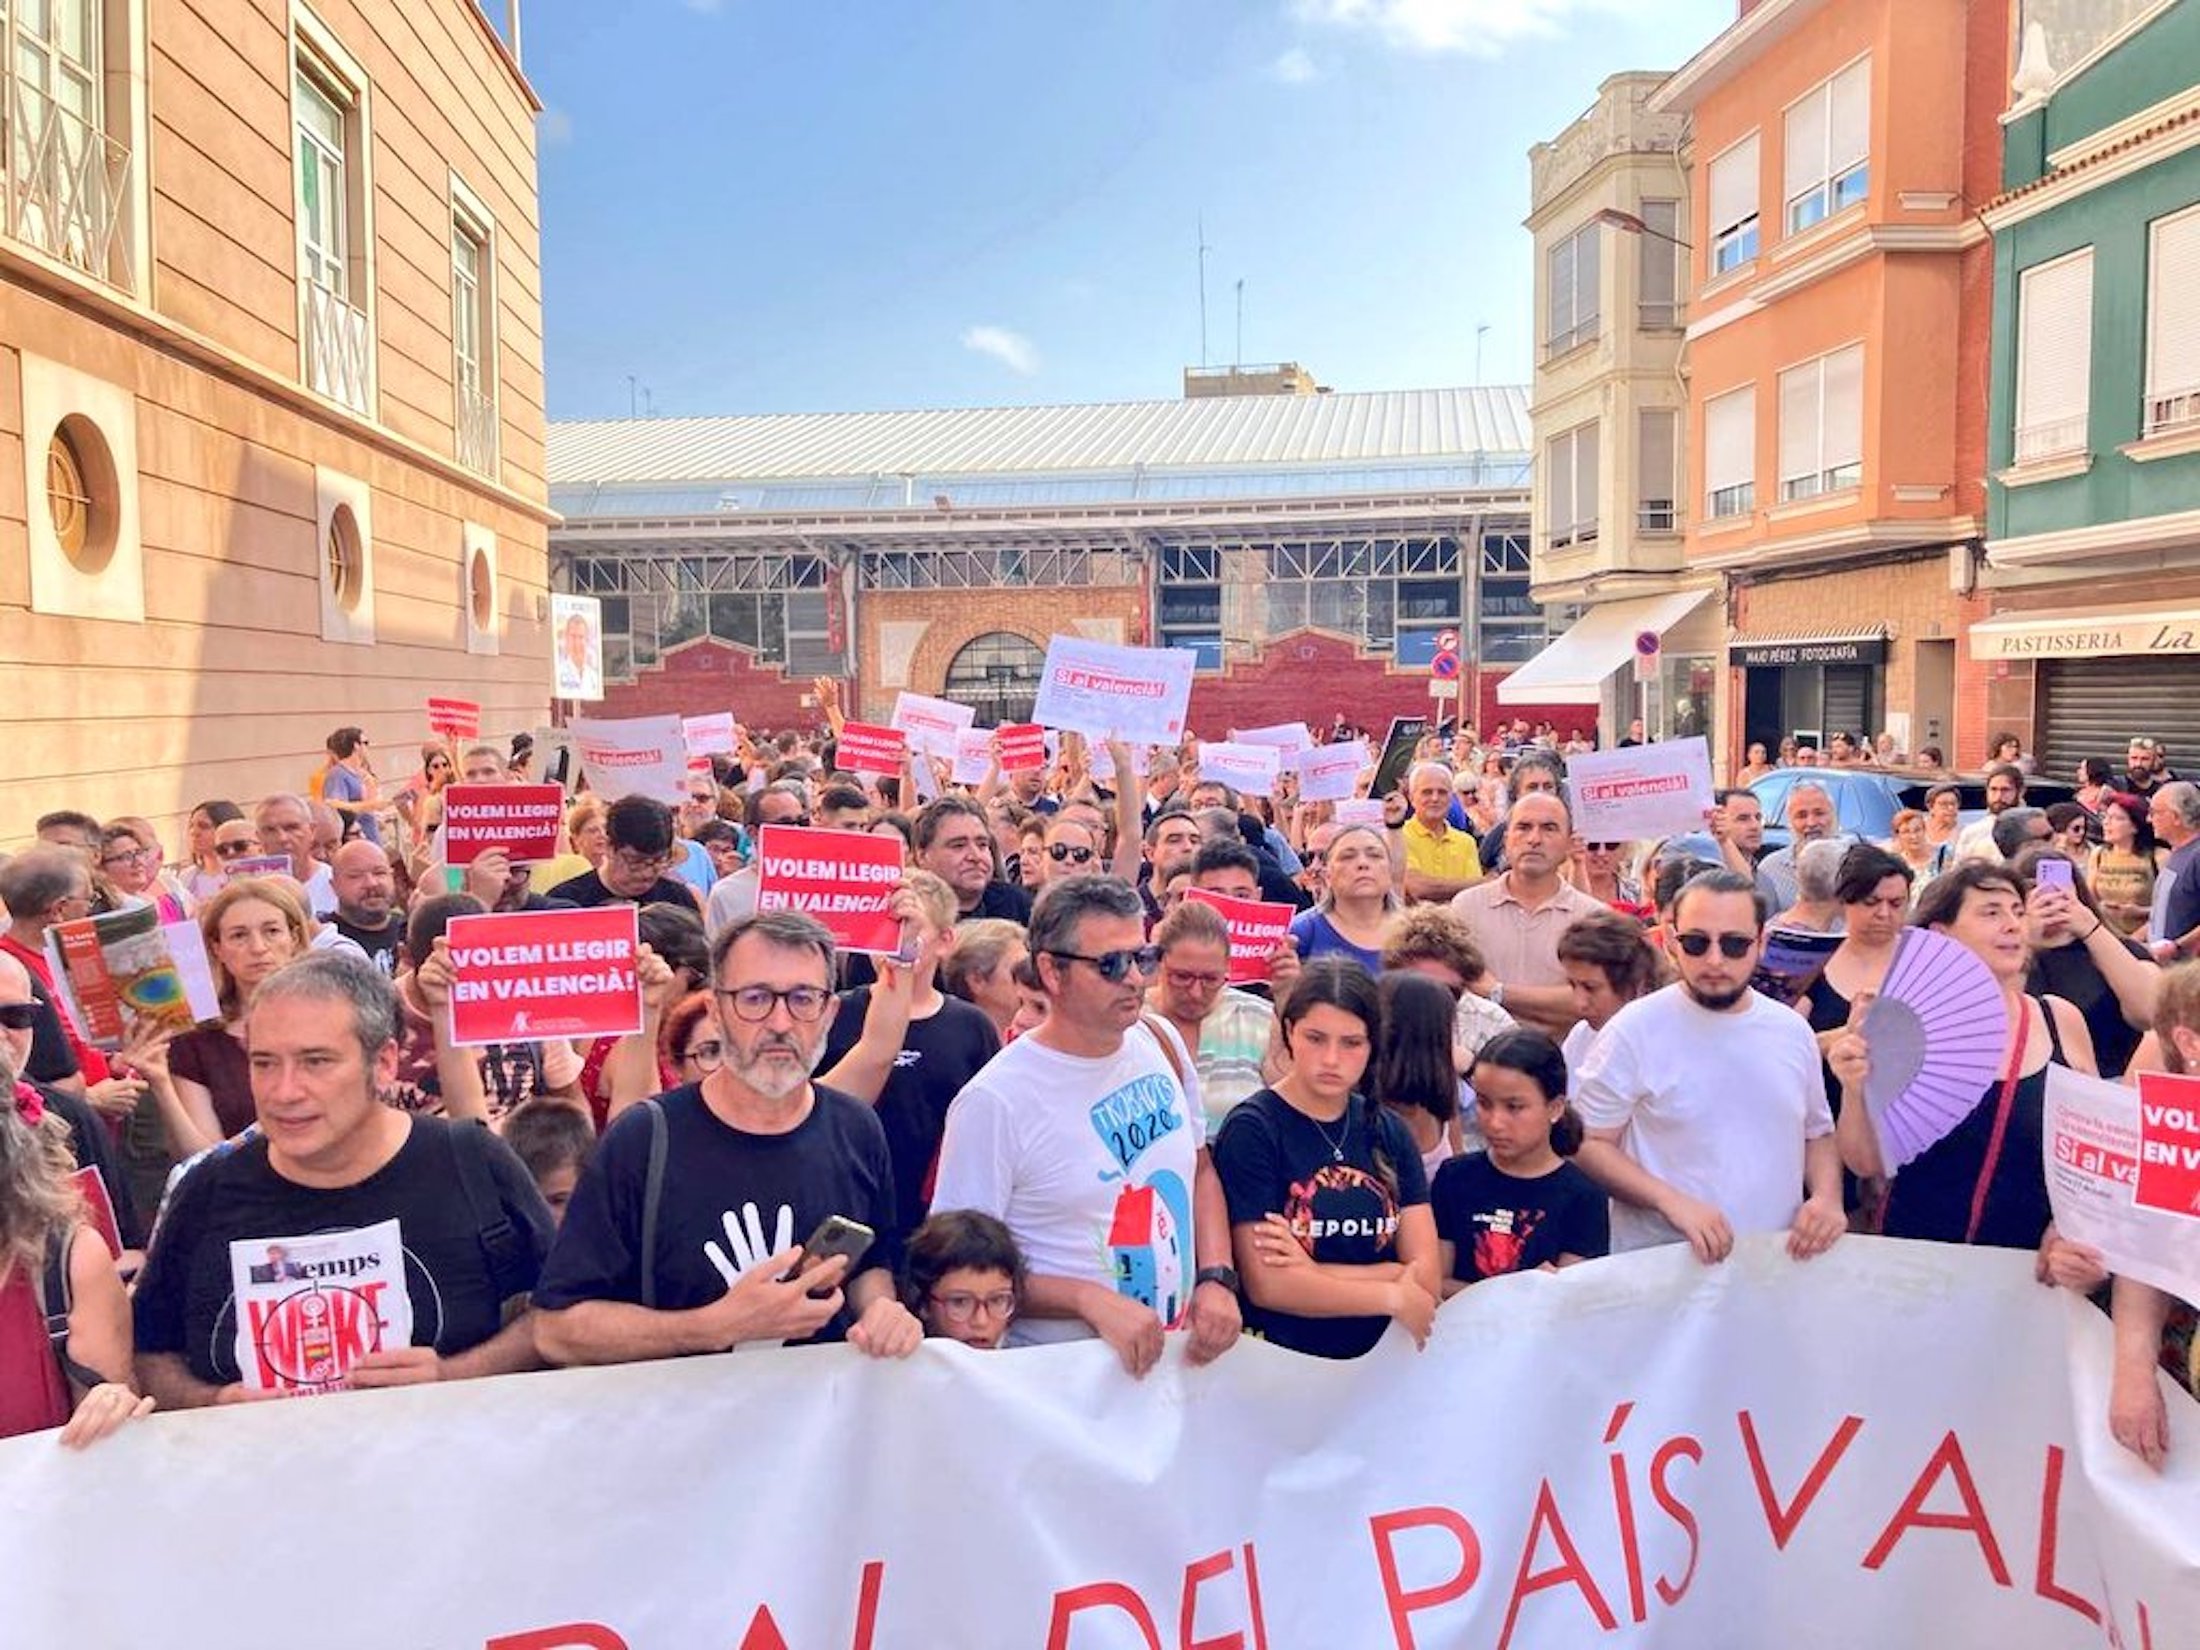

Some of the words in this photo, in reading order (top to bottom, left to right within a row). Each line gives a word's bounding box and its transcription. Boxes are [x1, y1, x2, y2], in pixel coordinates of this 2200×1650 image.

[2002, 632, 2122, 652] PASTISSERIA
[2149, 625, 2198, 649] La
[448, 805, 505, 819] VOLEM
[507, 805, 559, 818] LLEGIR
[448, 826, 469, 839] EN
[764, 858, 836, 881] VOLEM
[760, 891, 789, 910] EN
[451, 944, 543, 968] VOLEM
[547, 939, 630, 963] LLEGIR
[455, 980, 489, 1001] EN
[492, 967, 635, 999] VALENCIÀ!
[2081, 1150, 2105, 1174] al
[2143, 1140, 2177, 1166] EN
[301, 1251, 382, 1279] emps
[1369, 1401, 1703, 1650] PAÍS
